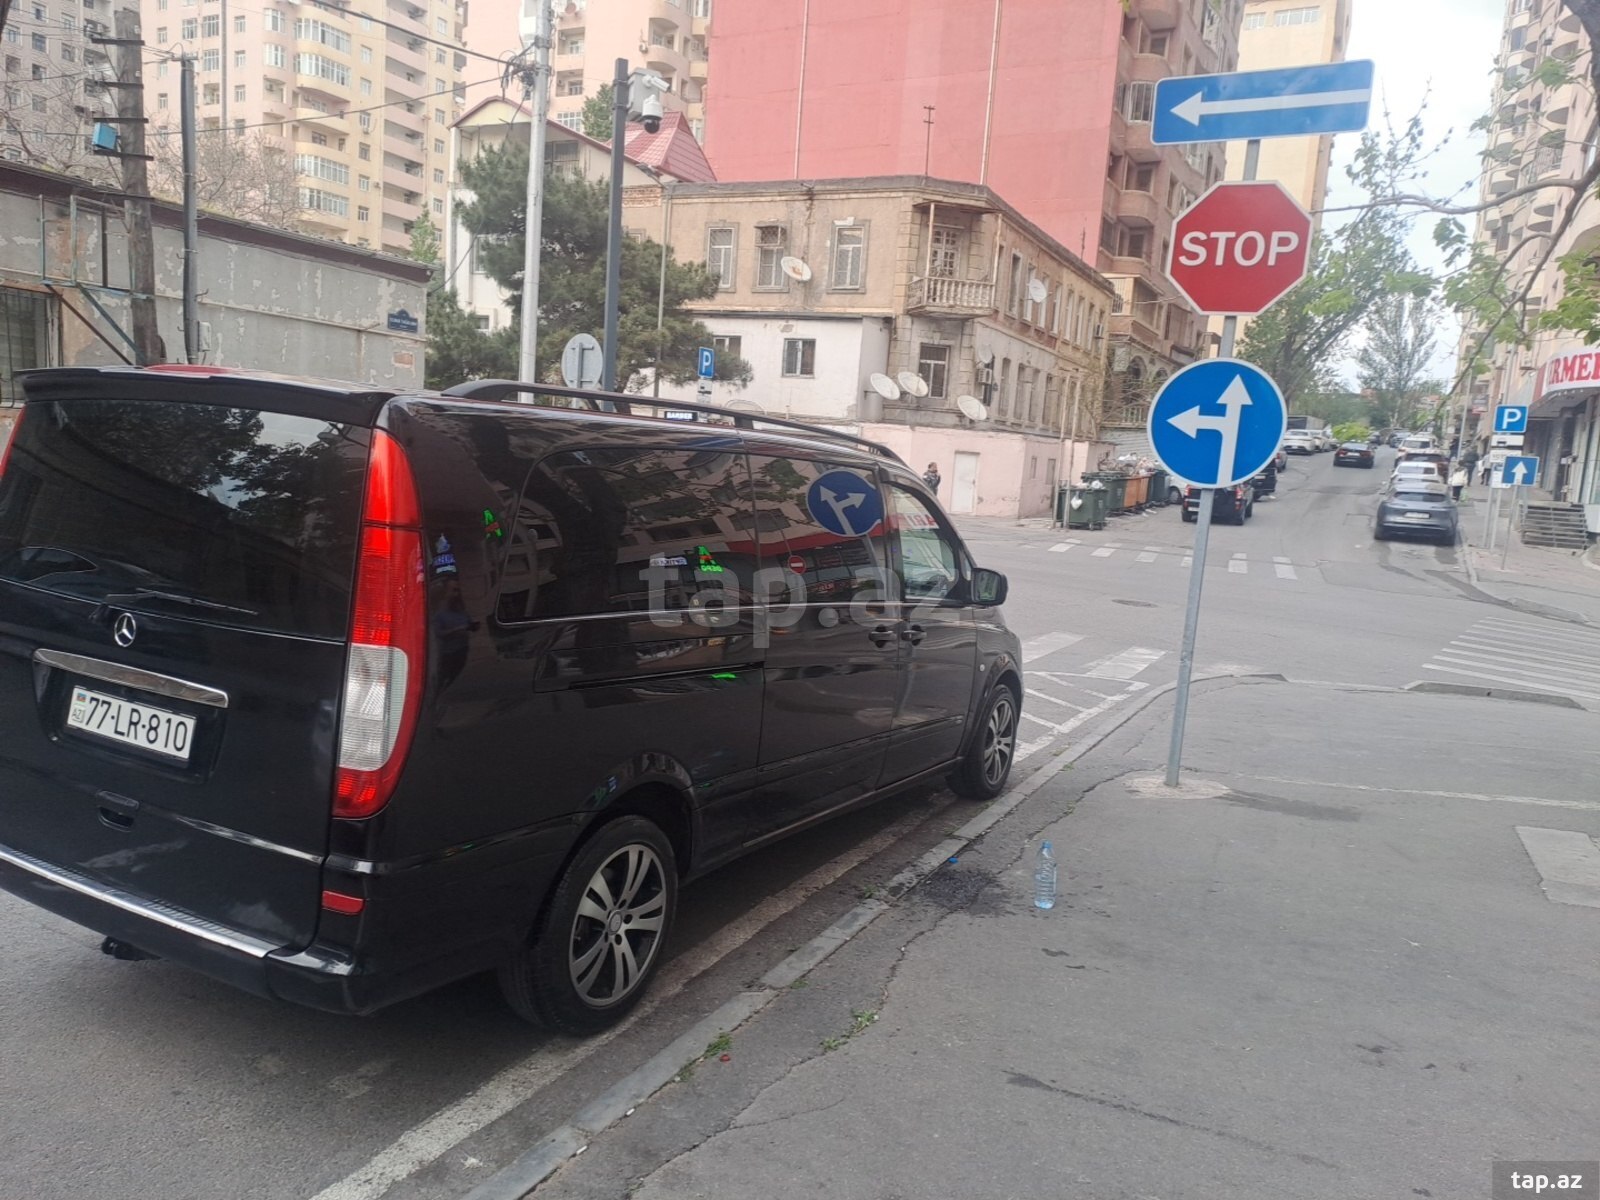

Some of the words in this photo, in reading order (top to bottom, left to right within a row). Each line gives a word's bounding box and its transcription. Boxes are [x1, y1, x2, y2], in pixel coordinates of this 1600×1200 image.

[1178, 230, 1300, 267] STOP
[702, 350, 712, 374] P
[1501, 408, 1522, 430] P
